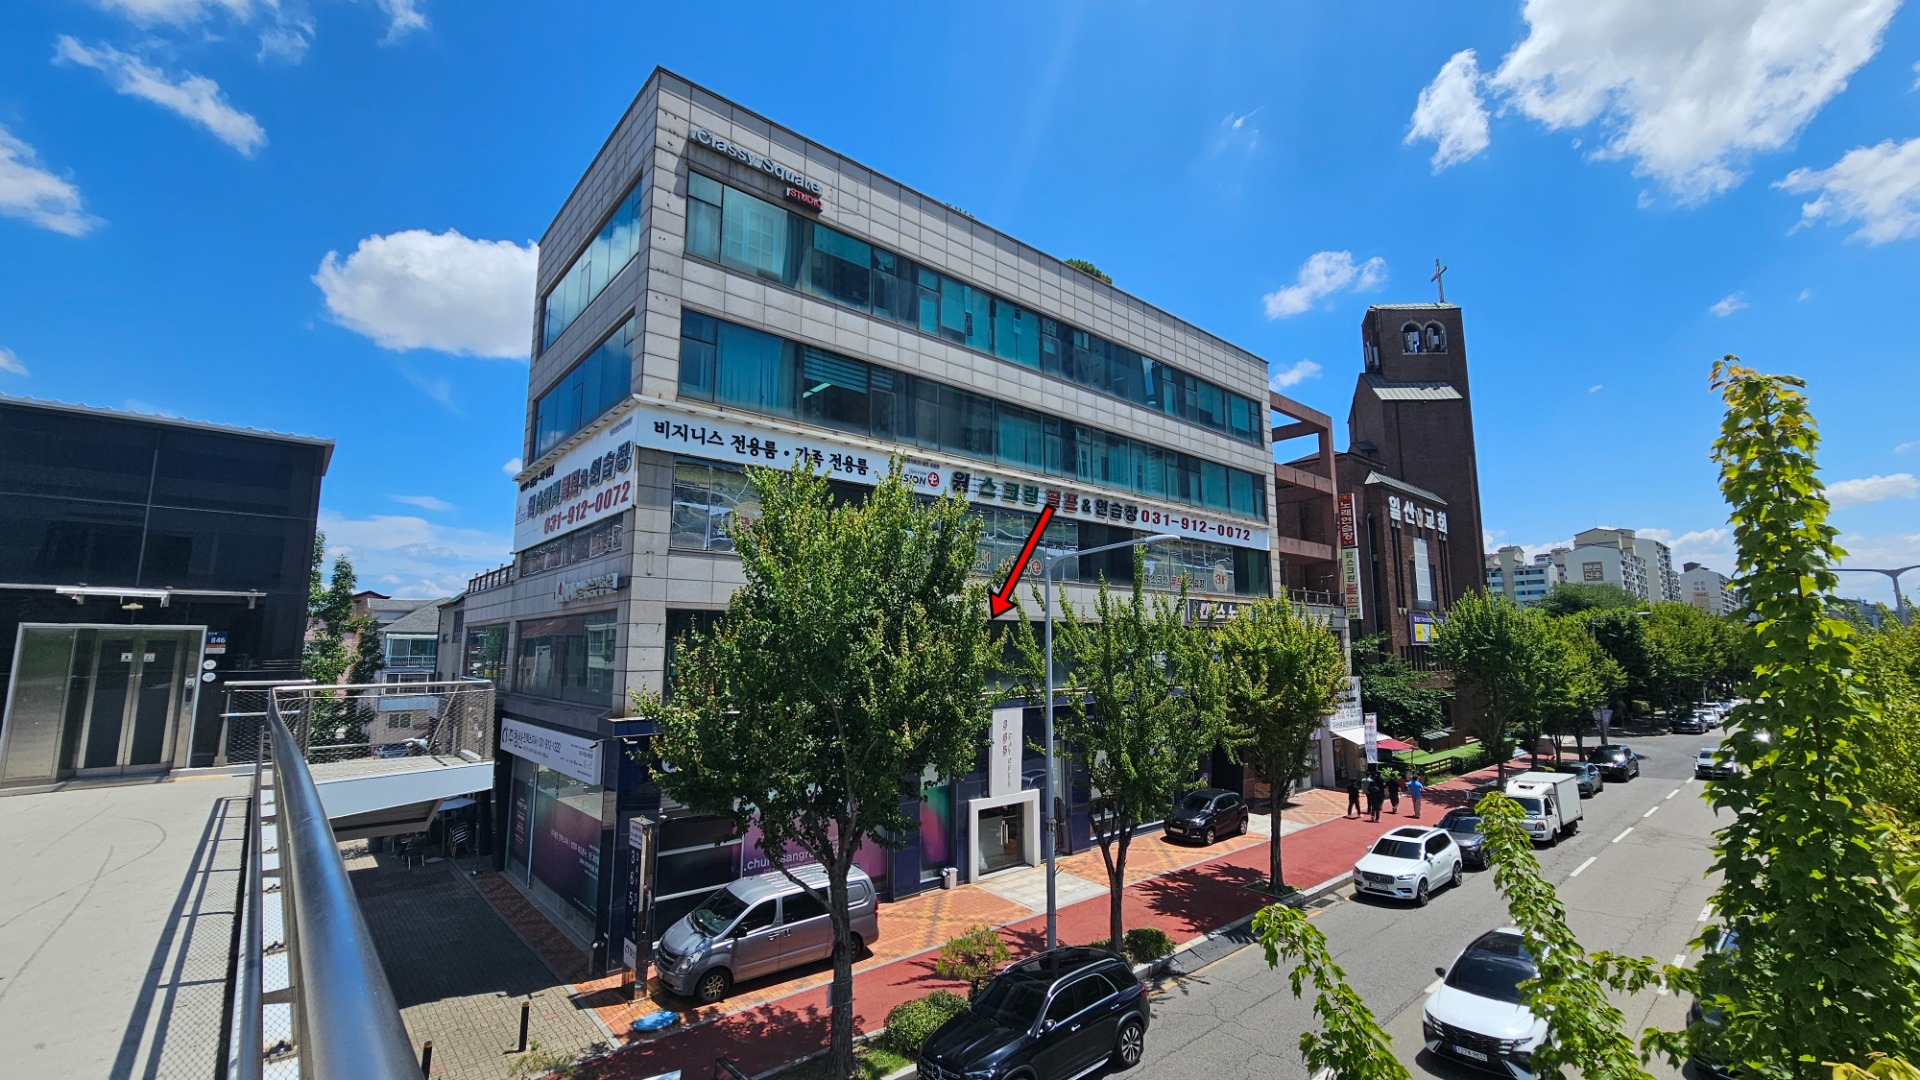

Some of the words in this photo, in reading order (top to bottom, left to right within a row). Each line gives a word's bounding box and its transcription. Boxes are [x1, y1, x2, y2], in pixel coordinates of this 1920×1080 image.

[696, 127, 755, 166] Classy
[761, 157, 819, 193] Square
[790, 187, 822, 209] STUDIO
[654, 421, 724, 446] 비지니스
[731, 435, 778, 459] 전용룸
[796, 447, 824, 467] 가족
[830, 453, 869, 475] 전용룸
[544, 480, 631, 534] 031-912-0072
[1141, 510, 1250, 541] 031-912-0072
[1388, 495, 1448, 534] 일산교회
[210, 636, 226, 644] 846
[628, 849, 636, 906] 365
